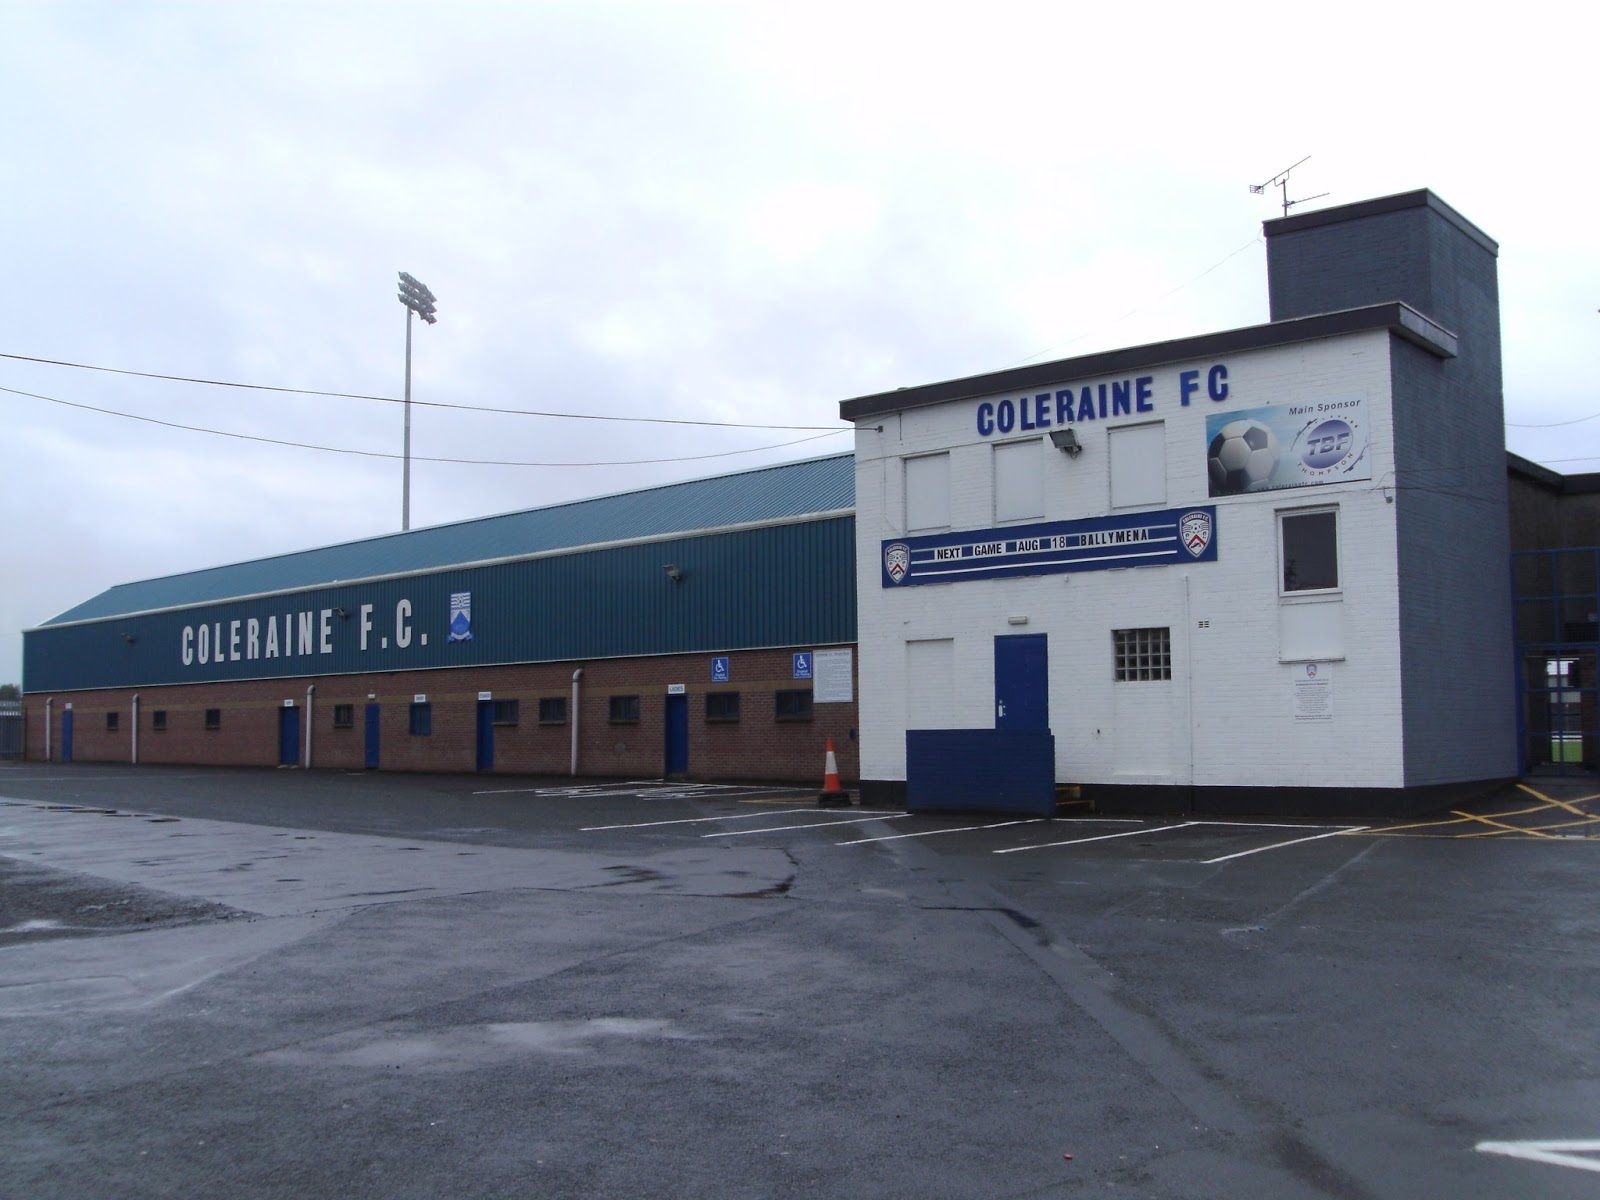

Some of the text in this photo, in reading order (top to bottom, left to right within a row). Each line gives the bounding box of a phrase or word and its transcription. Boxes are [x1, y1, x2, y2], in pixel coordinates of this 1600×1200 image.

[976, 376, 1153, 436] COLERAINE
[1288, 399, 1361, 416] Main Sponsor
[1307, 432, 1350, 456] TBF
[1297, 452, 1354, 476] THOMPSON
[936, 528, 1148, 560] NEXT GAME AUG 18 BALLYMENA
[182, 598, 428, 666] COLERAINE F.C.
